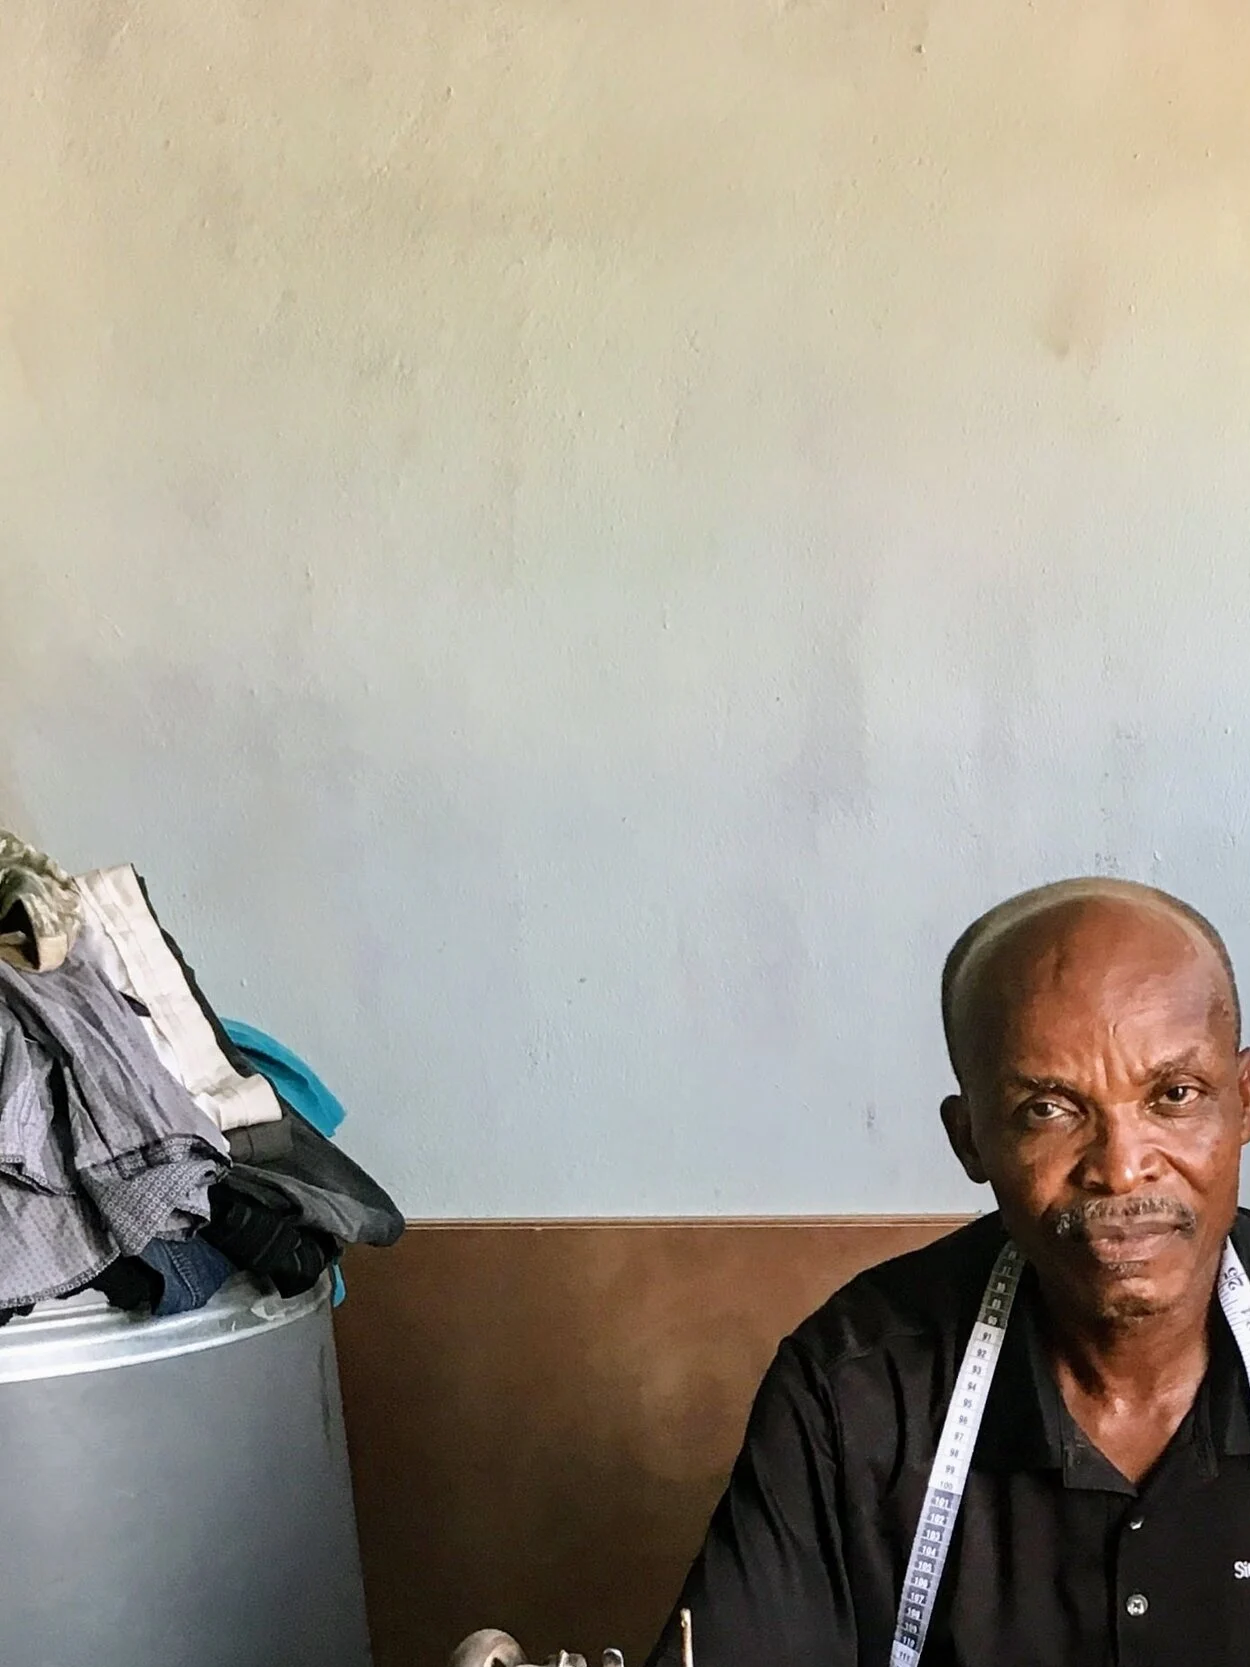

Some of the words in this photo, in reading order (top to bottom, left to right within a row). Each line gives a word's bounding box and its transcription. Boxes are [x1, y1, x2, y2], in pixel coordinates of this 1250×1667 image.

[1224, 1267, 1244, 1291] 25
[935, 1496, 949, 1508] 101
[922, 1545, 937, 1557] 104
